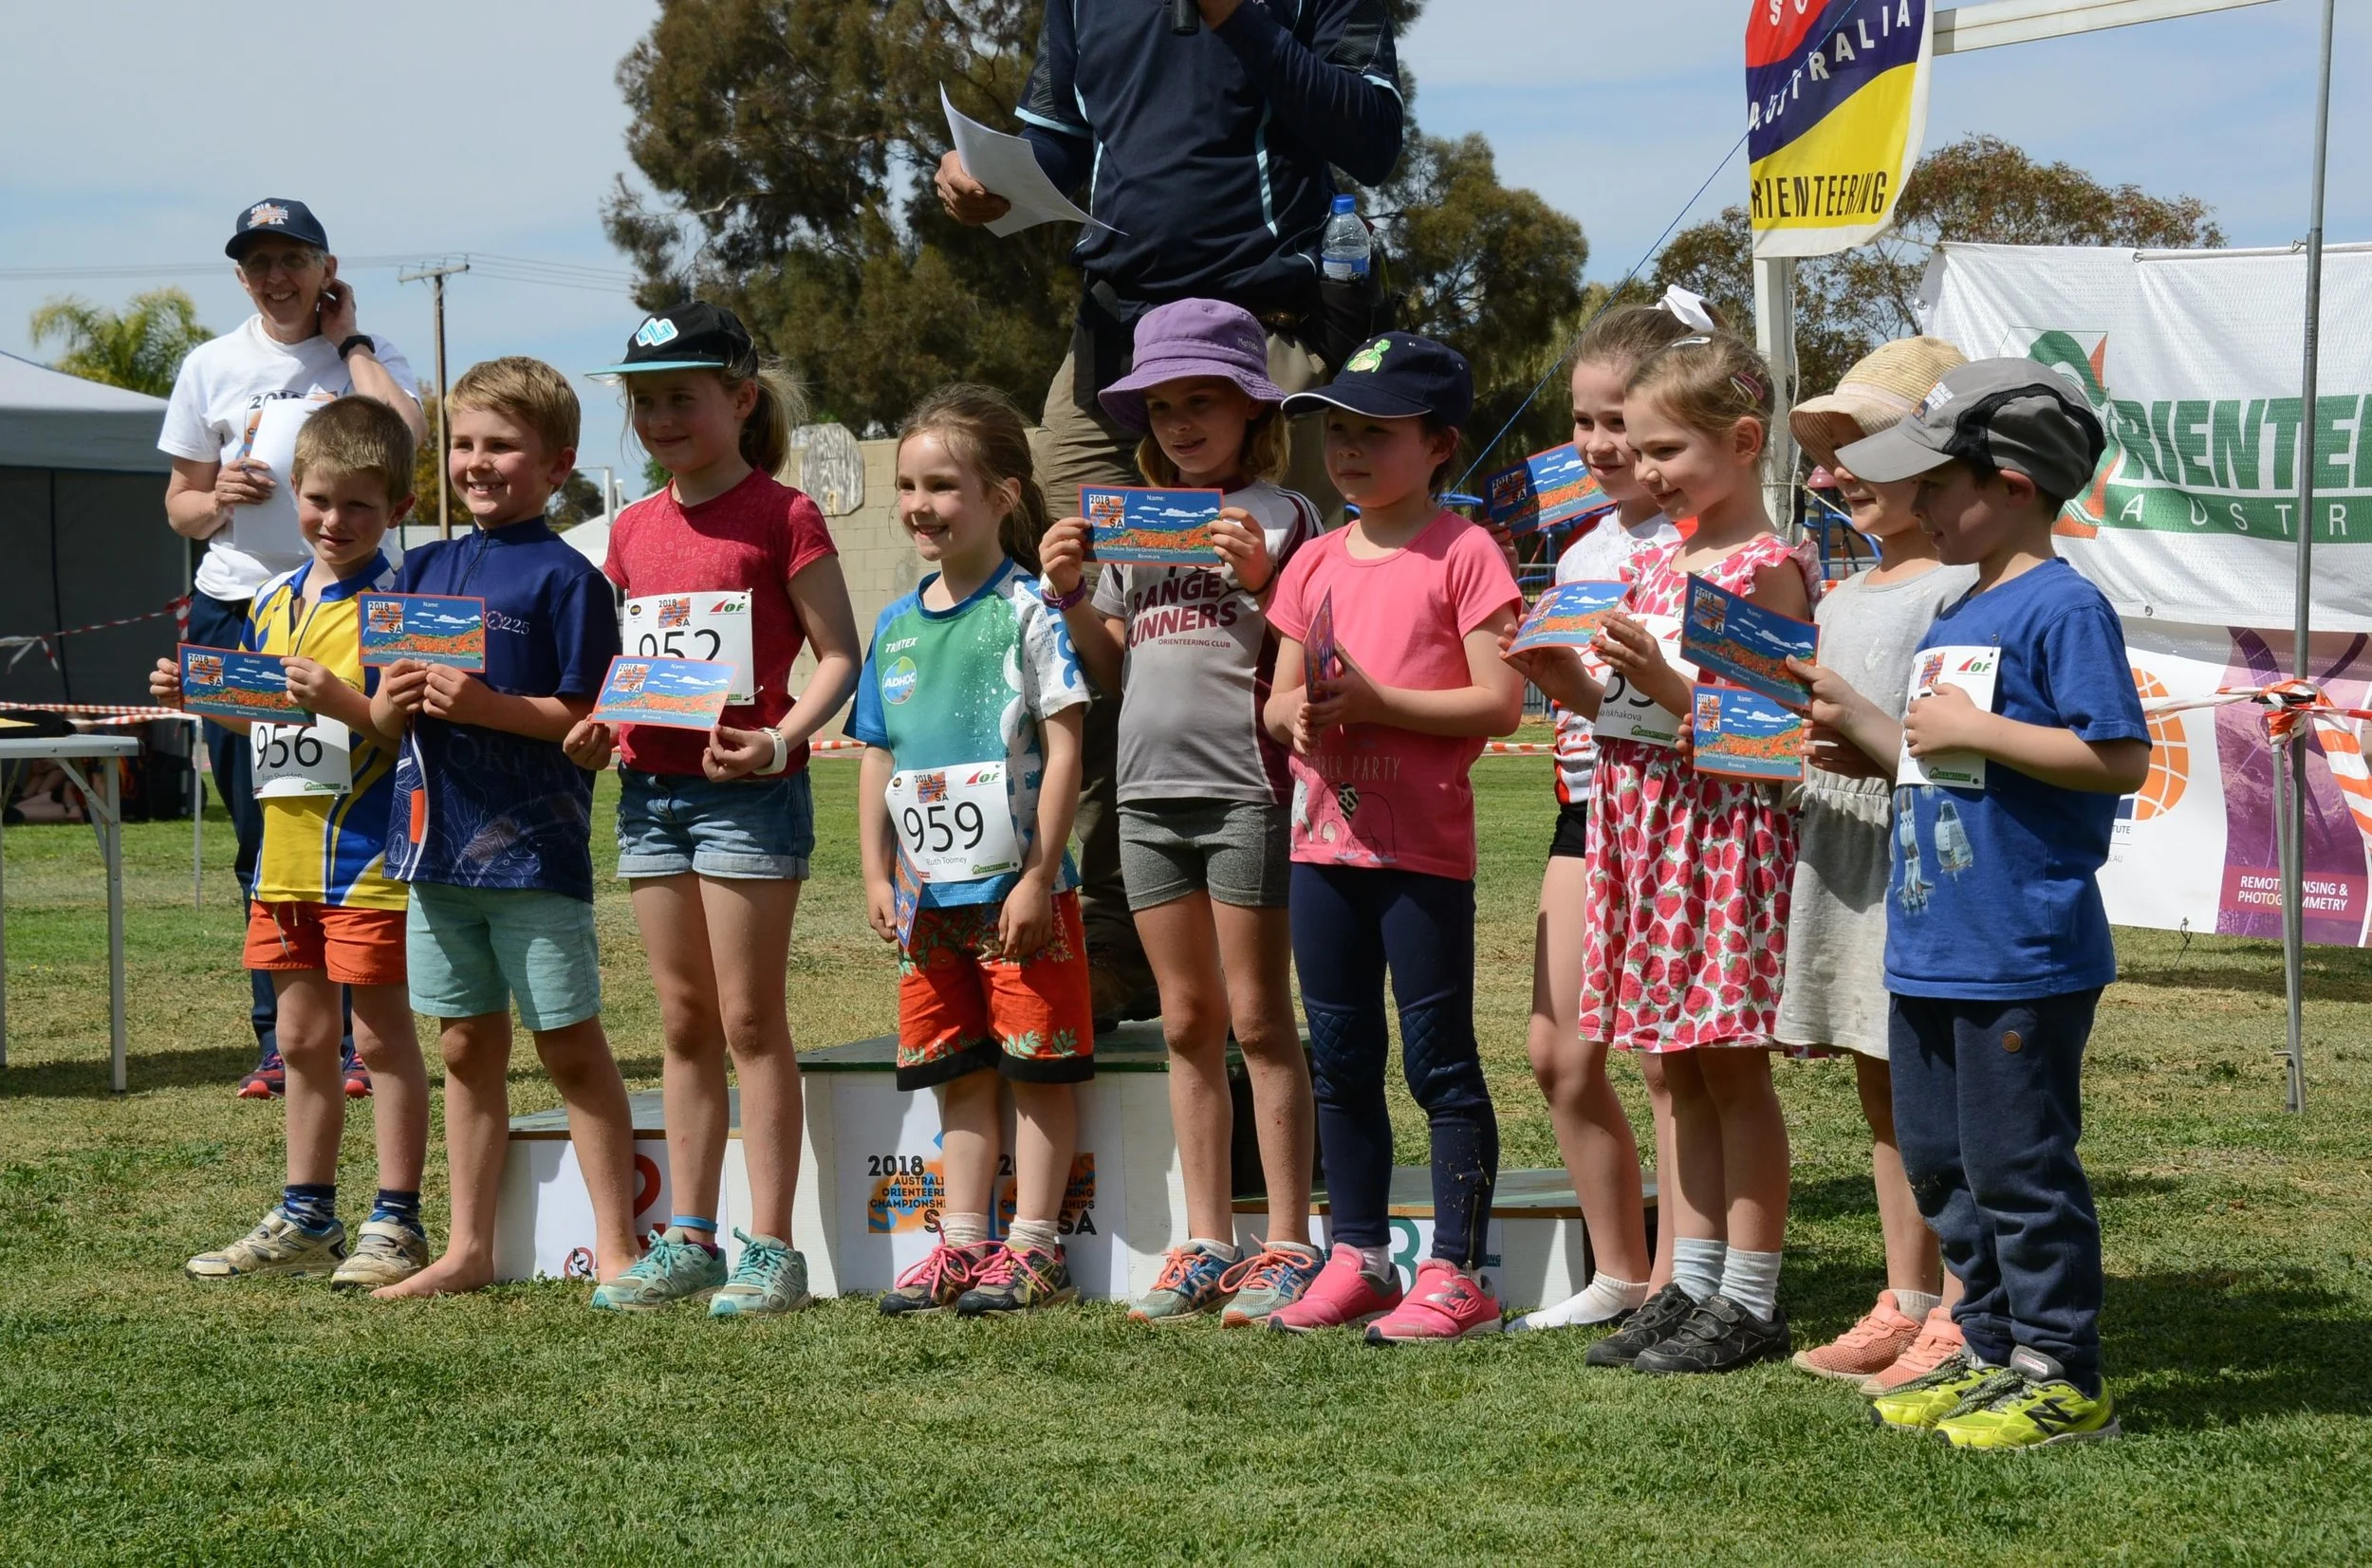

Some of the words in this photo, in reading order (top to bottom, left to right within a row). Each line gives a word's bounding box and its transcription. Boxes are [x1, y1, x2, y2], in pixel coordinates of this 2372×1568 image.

[1749, 0, 1911, 131] AUSTRALIA
[1090, 495, 1110, 505] 2018
[1109, 518, 1124, 528] SA
[1134, 572, 1222, 616] RANGE
[369, 601, 390, 611] 2018
[658, 599, 677, 607] 2018
[676, 618, 691, 627] SA
[389, 623, 403, 634] SA
[1158, 638, 1211, 647] ORIENTEERING
[1211, 640, 1231, 649] CLUB
[189, 655, 209, 664] 2018
[619, 664, 638, 673] 2018
[208, 676, 223, 686] SA
[628, 683, 641, 692] SA
[1697, 694, 1712, 704] 2018
[256, 724, 324, 770] 956
[914, 774, 933, 784] 2018
[935, 793, 950, 802] SA
[903, 802, 984, 853] 959
[926, 858, 942, 866] Ruth
[942, 857, 968, 865] Toomey
[2240, 876, 2281, 891] REMOT
[2302, 880, 2337, 895] NSING
[2339, 883, 2348, 896] &
[868, 1155, 925, 1176] 2018
[894, 1176, 944, 1186] AUSTRALI
[881, 1188, 945, 1197] ORIENTEERI
[1057, 1209, 1098, 1235] SA
